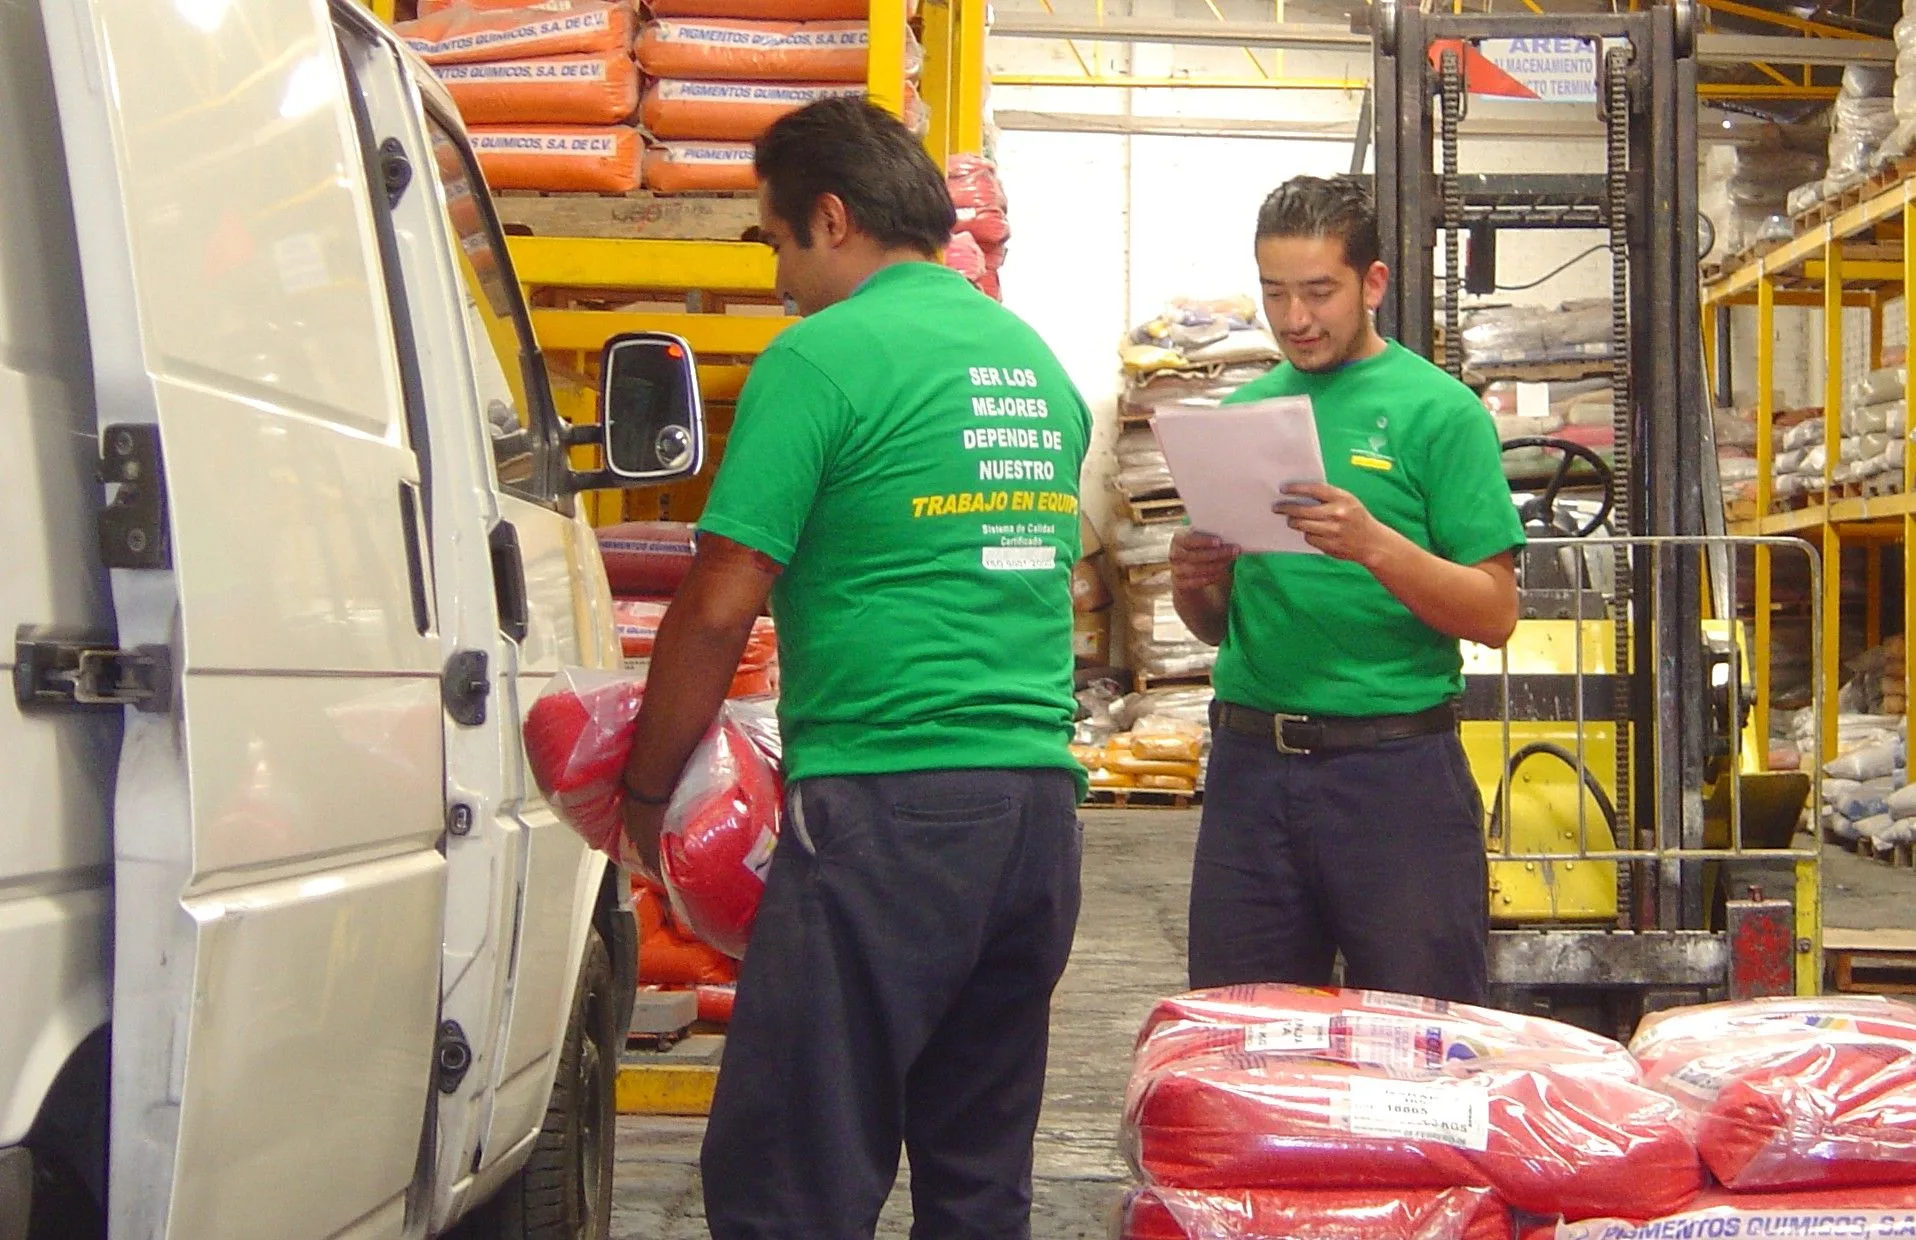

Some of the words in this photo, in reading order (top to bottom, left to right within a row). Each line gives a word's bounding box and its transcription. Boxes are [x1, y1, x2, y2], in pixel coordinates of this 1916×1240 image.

[565, 18, 581, 30] DE
[678, 27, 749, 44] PIGMENTOS
[840, 32, 858, 44] DE
[561, 65, 577, 77] DE
[680, 83, 751, 98] PIGMENTOS
[571, 138, 588, 150] DE
[683, 148, 756, 161] PIGMENTOS
[968, 367, 1002, 386] SER
[1002, 367, 1037, 388] LOS
[971, 397, 1048, 418] MEJORES
[963, 428, 1039, 449] DEPENDE
[1042, 431, 1062, 450] DE
[979, 460, 1054, 481] NUESTRO
[912, 491, 1008, 518] TRABAJO
[1011, 491, 1034, 511] EN
[982, 523, 1015, 535] Sistema
[1015, 524, 1026, 534] de
[1027, 523, 1055, 534] Calidad
[1000, 536, 1043, 547] Certificado
[1601, 1217, 1742, 1240] PIGMENTOS
